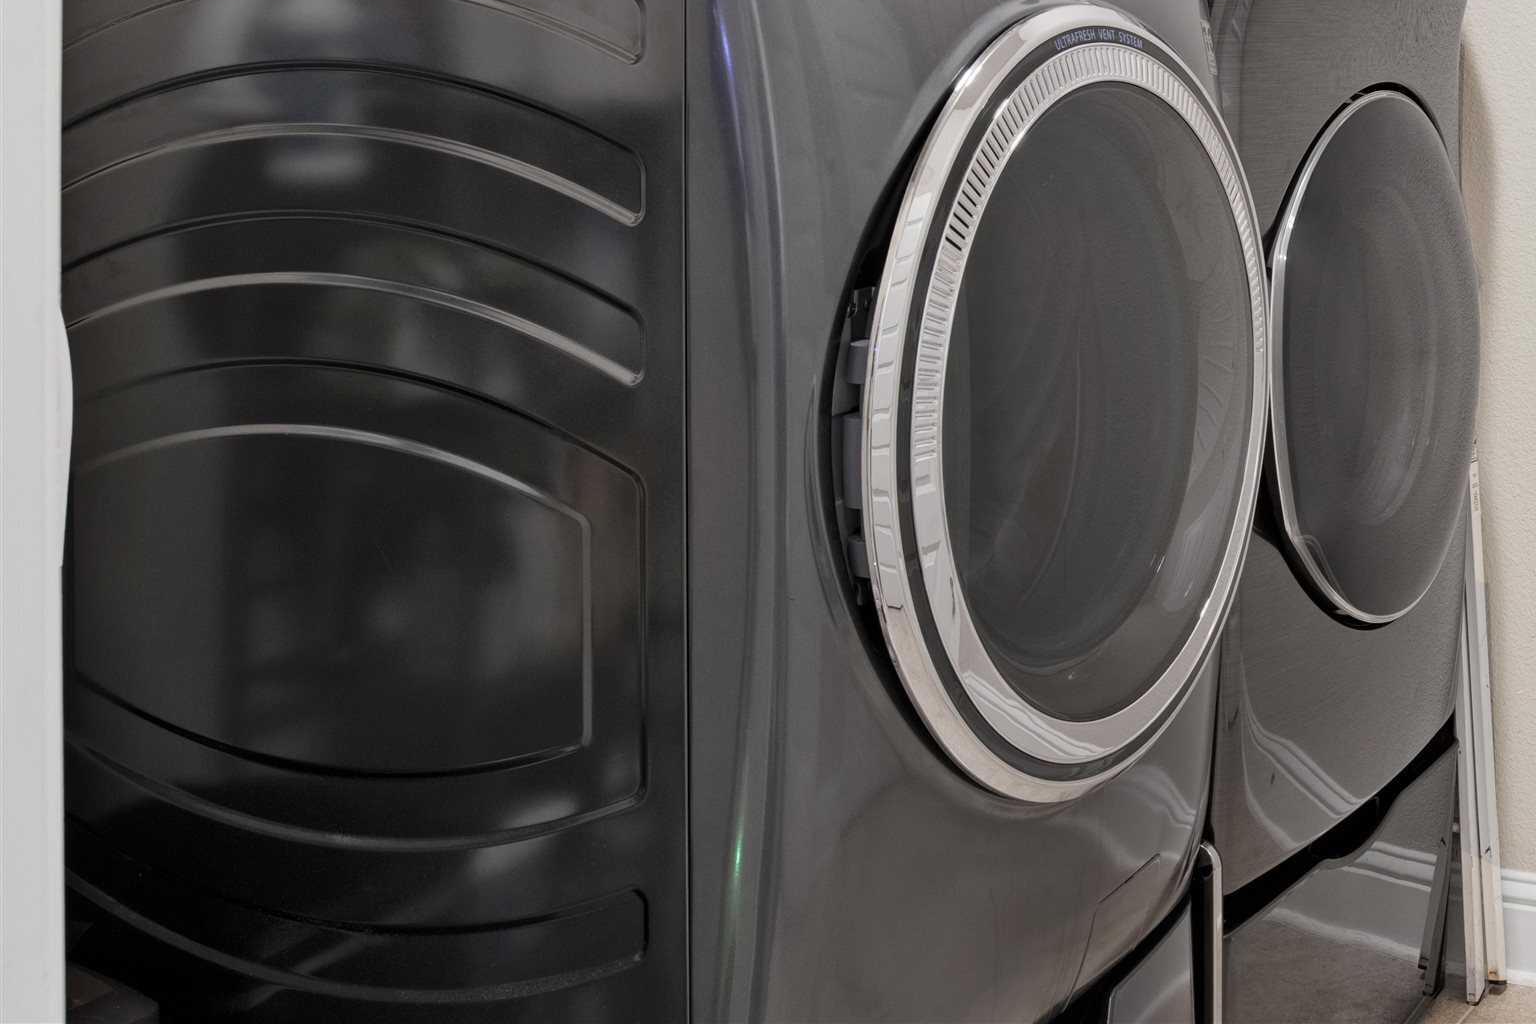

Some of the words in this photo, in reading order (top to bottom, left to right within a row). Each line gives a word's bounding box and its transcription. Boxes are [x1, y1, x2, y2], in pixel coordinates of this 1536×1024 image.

[1054, 29, 1097, 51] ULTRAFRESH
[1097, 29, 1115, 41] VENT
[1118, 31, 1143, 49] SYSTEM
